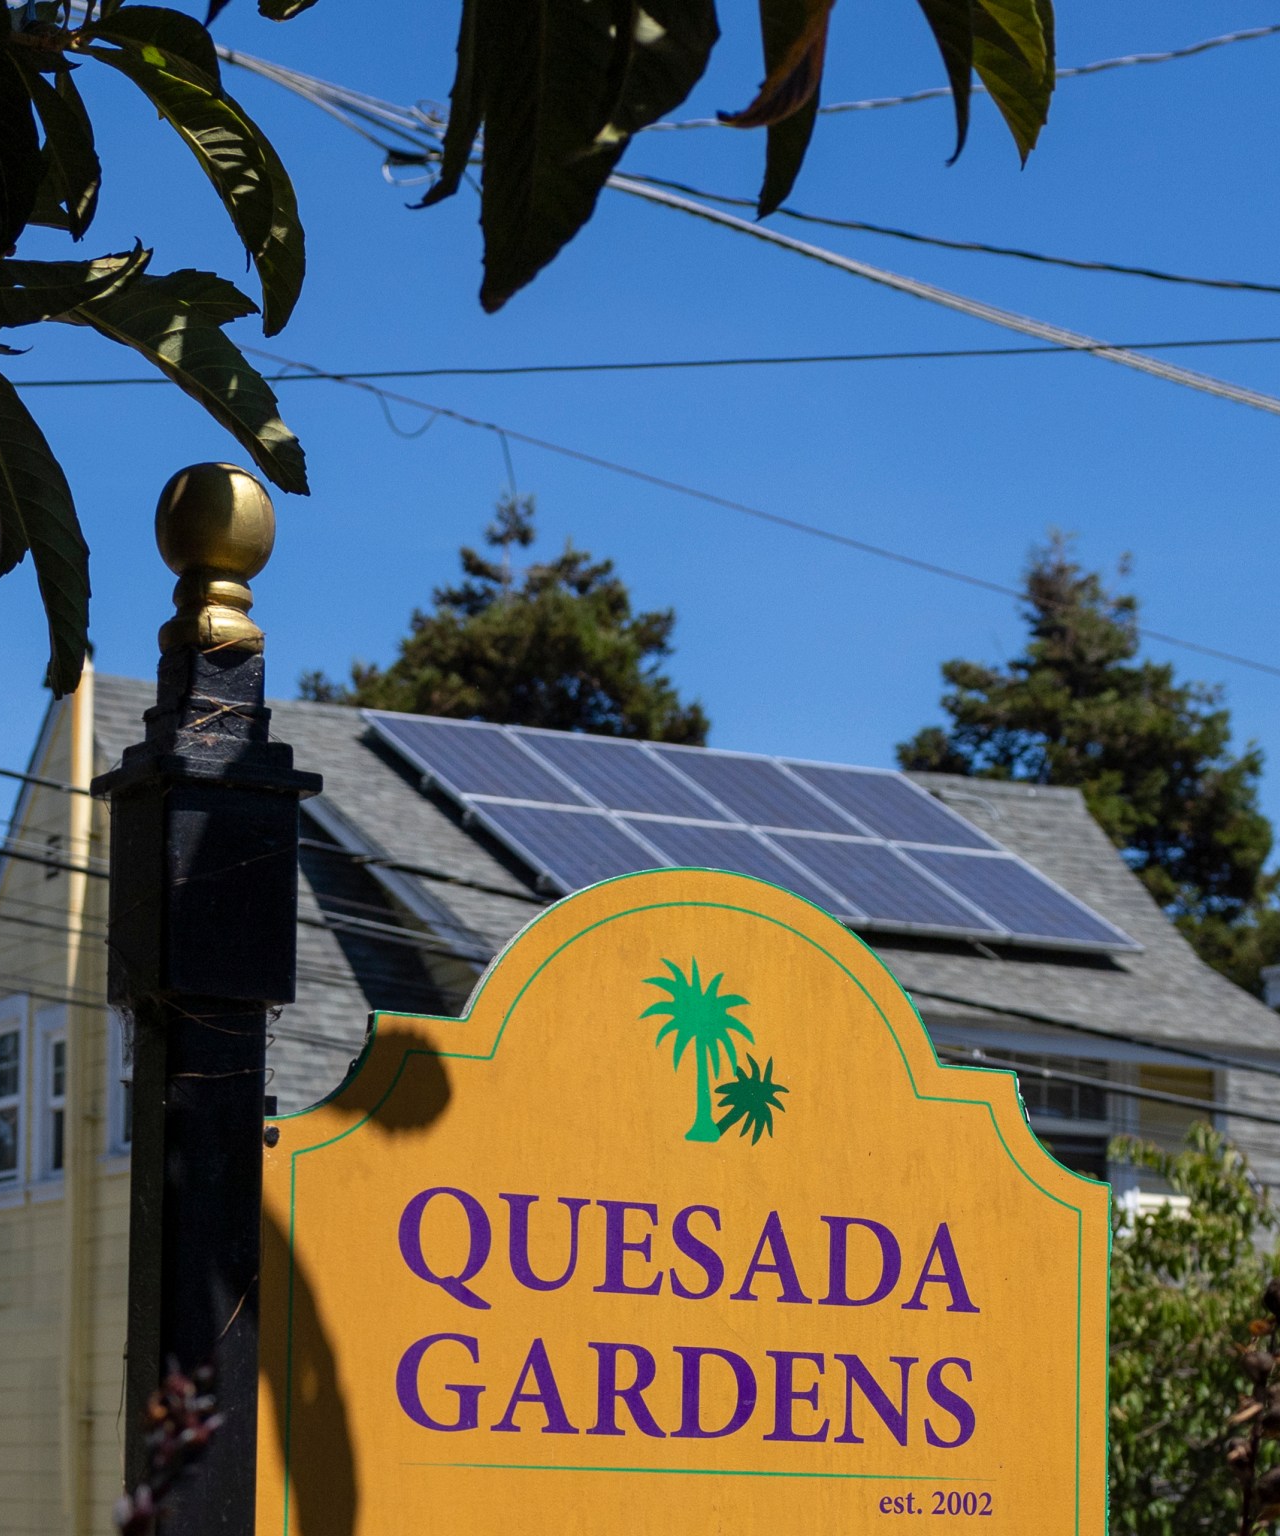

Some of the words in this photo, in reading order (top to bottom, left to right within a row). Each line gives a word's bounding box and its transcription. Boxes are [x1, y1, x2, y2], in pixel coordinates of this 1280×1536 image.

[396, 1186, 982, 1314] QUESADA
[395, 1332, 977, 1450] GARDENS
[878, 1492, 923, 1516] est.
[931, 1490, 994, 1517] 2002
